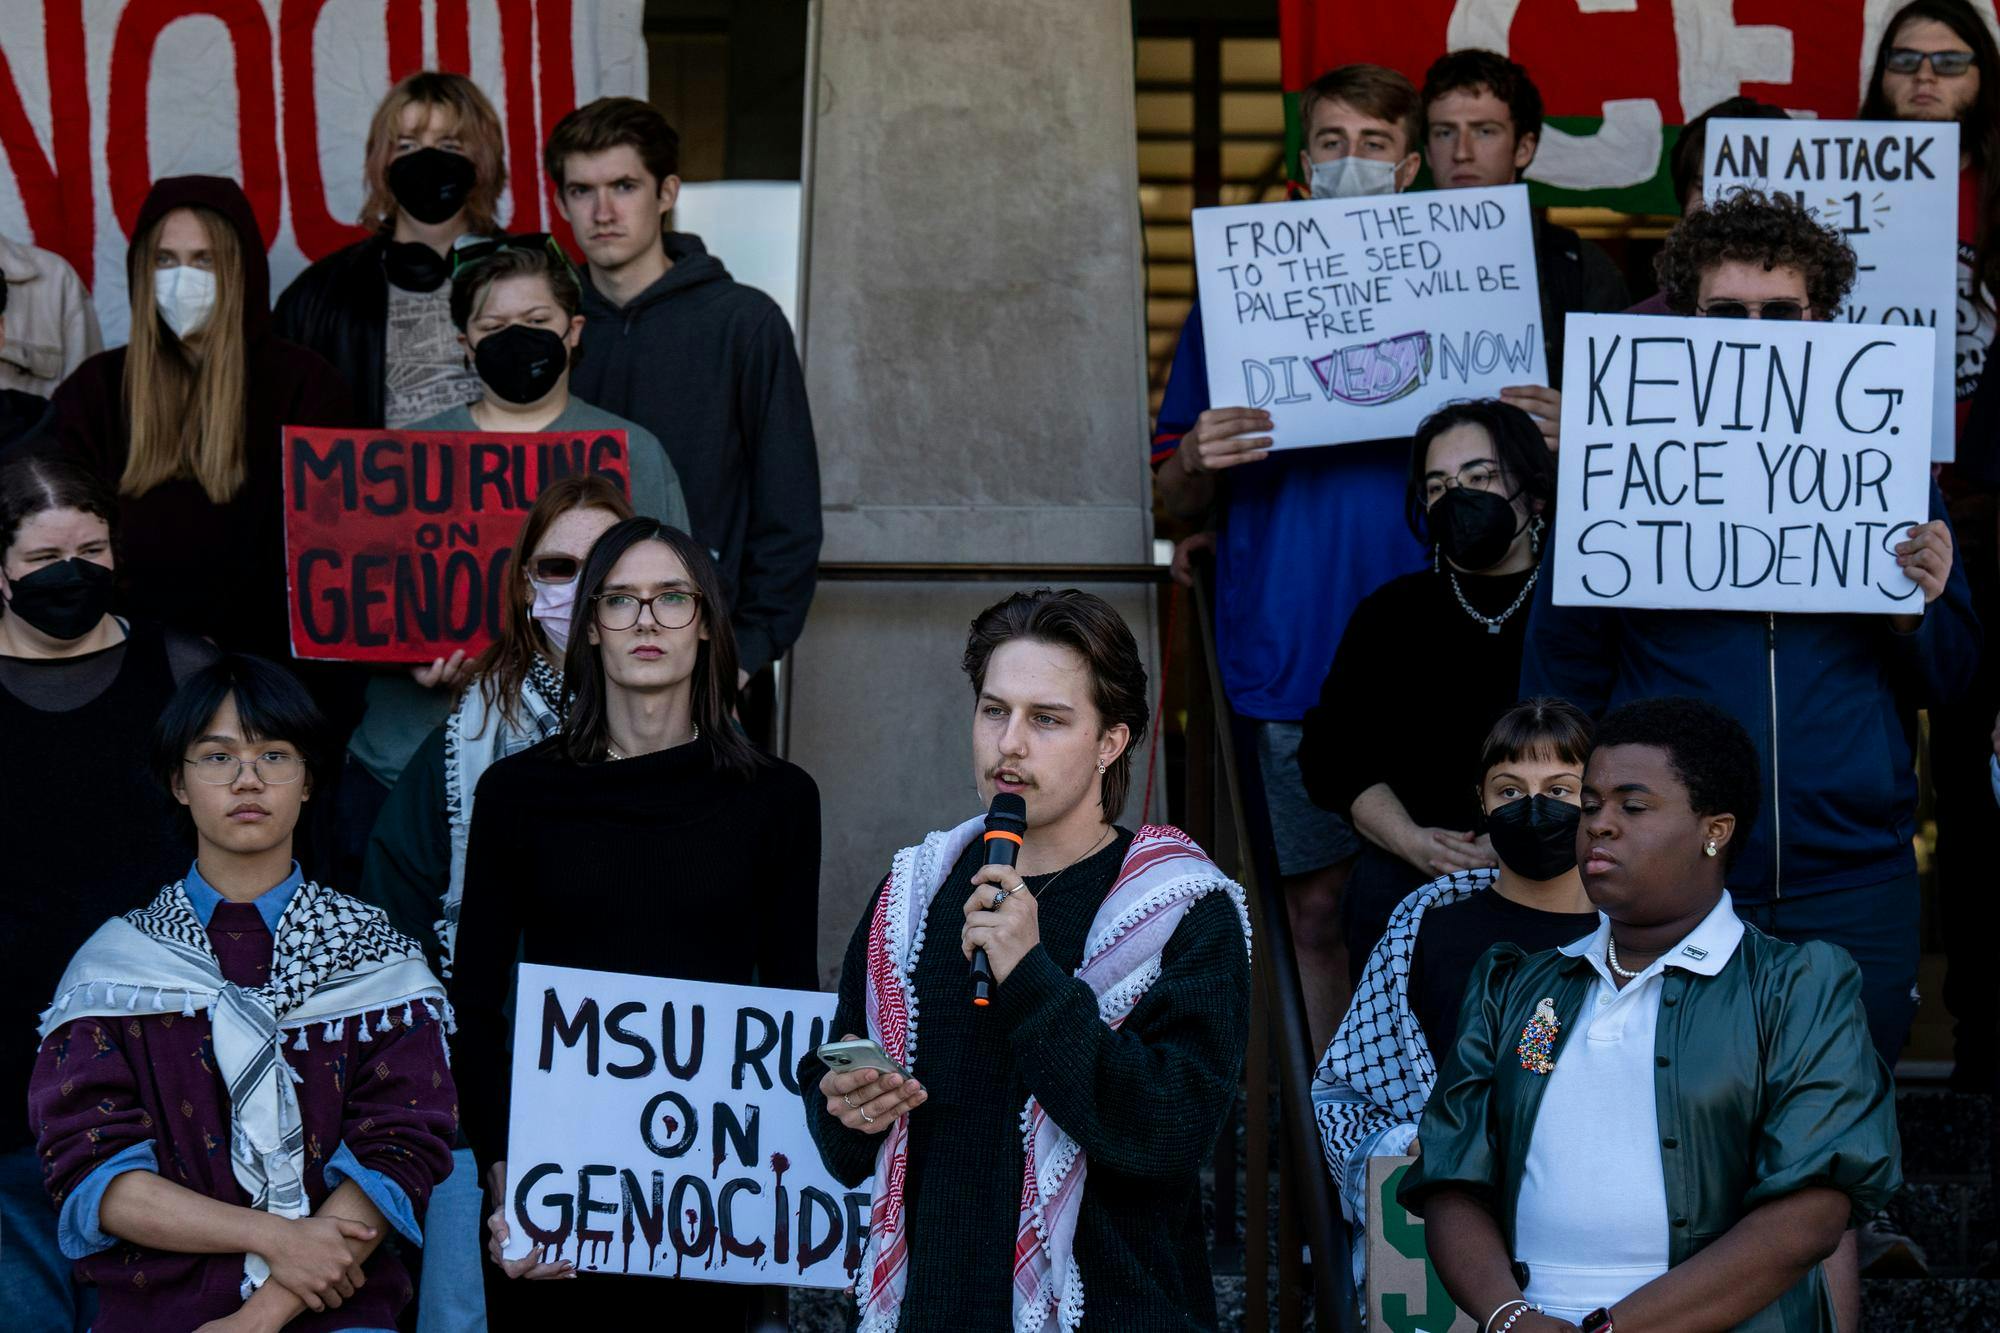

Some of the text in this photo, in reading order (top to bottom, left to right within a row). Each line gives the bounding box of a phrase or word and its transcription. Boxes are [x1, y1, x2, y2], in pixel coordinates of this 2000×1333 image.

[1714, 134, 1936, 181] AN ATTACK
[1218, 240, 1442, 290] TO THE SEED
[1226, 200, 1506, 258] FROM THE RIND
[1235, 264, 1521, 324] PALESTINE WILL BE
[1304, 308, 1376, 341] FREE
[1242, 324, 1536, 409] DIVEST NOW
[1587, 334, 1905, 436] KEVIN G.
[292, 436, 453, 517] MSU
[1582, 440, 1893, 514] FACE YOUR
[415, 522, 479, 549] ON
[1577, 519, 1920, 600] STUDENTS
[538, 986, 836, 1096] MSU RU
[640, 1090, 761, 1174] ON
